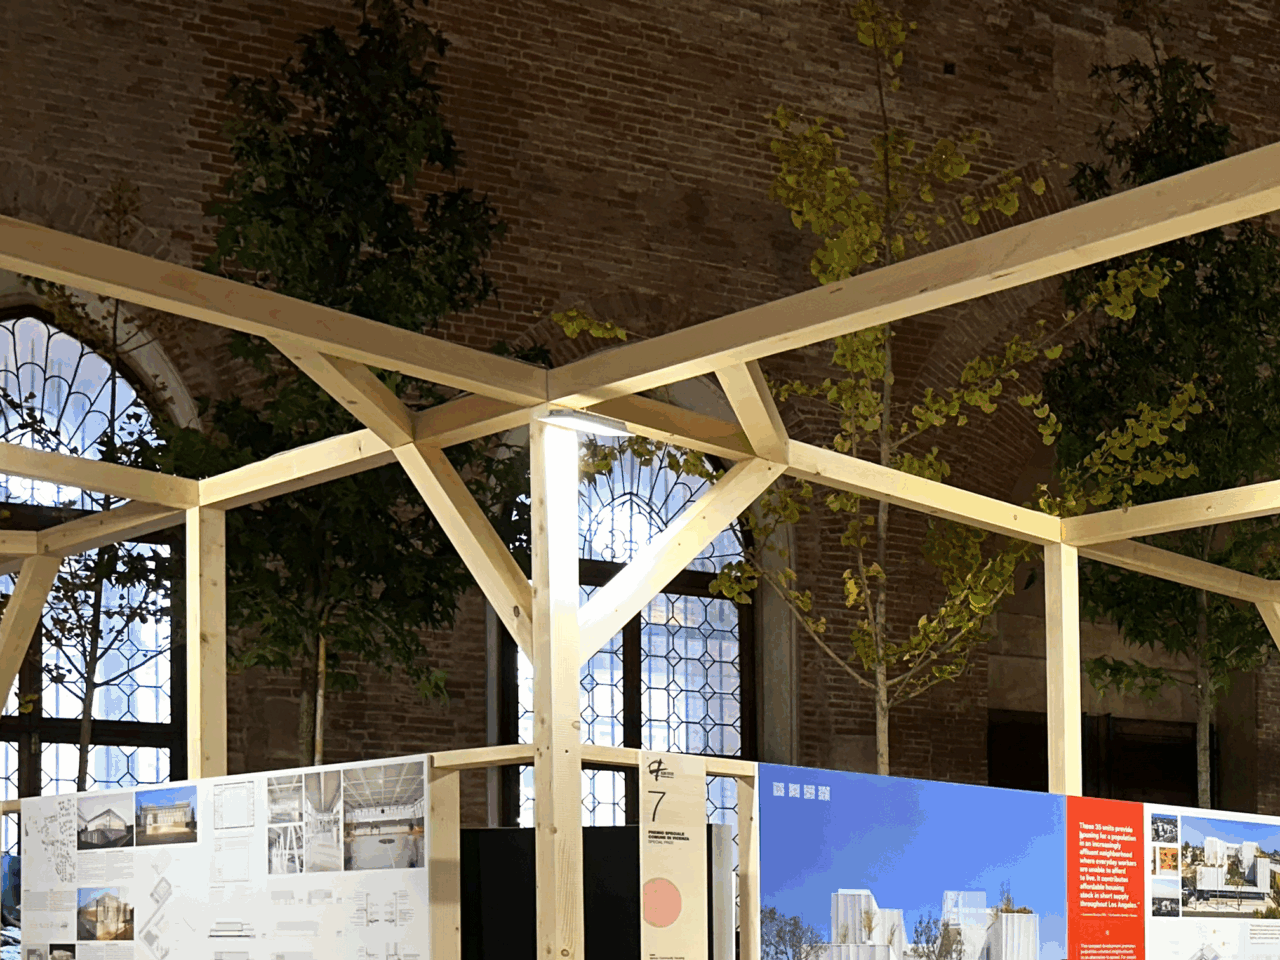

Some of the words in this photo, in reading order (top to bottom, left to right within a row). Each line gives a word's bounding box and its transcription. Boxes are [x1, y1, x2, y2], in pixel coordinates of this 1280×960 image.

[647, 790, 667, 823] 7
[1079, 822, 1095, 830] These
[1095, 823, 1102, 831] 35
[1111, 834, 1137, 842] population
